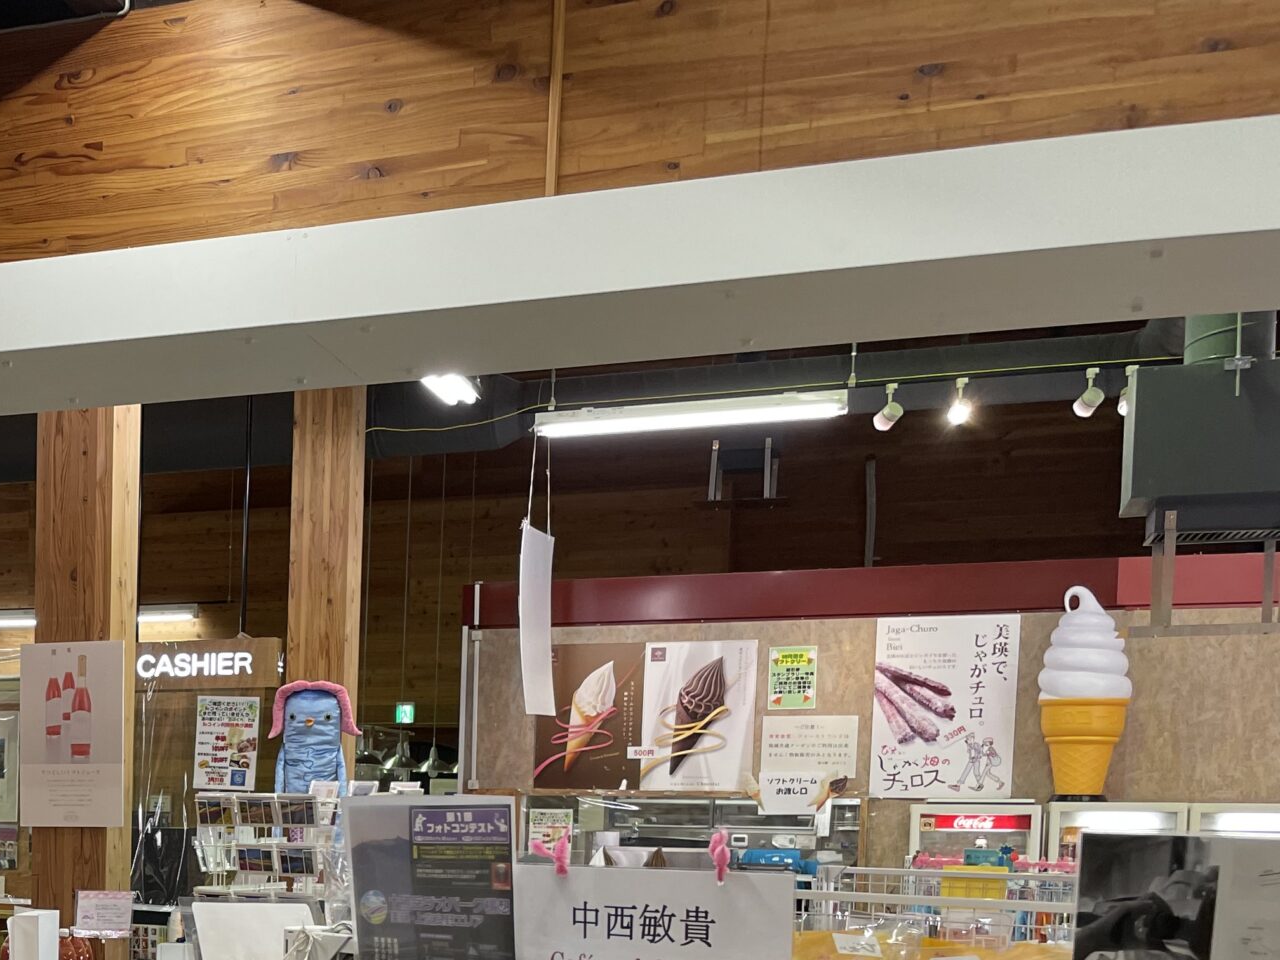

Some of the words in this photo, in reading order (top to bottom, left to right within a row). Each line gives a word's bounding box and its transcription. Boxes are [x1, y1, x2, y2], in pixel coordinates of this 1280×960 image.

[991, 624, 1010, 682] 美瑛で、
[136, 652, 253, 678] CASHIER
[969, 633, 987, 727] じゃがチュロ。
[943, 725, 967, 742] 330円
[633, 749, 655, 757] 500円
[883, 769, 946, 792] チュロス
[776, 787, 809, 795] お渡し口
[426, 823, 495, 834] フォトコンテスト
[953, 816, 996, 830] Coca-Cola
[571, 900, 717, 948] 中西敏貴
